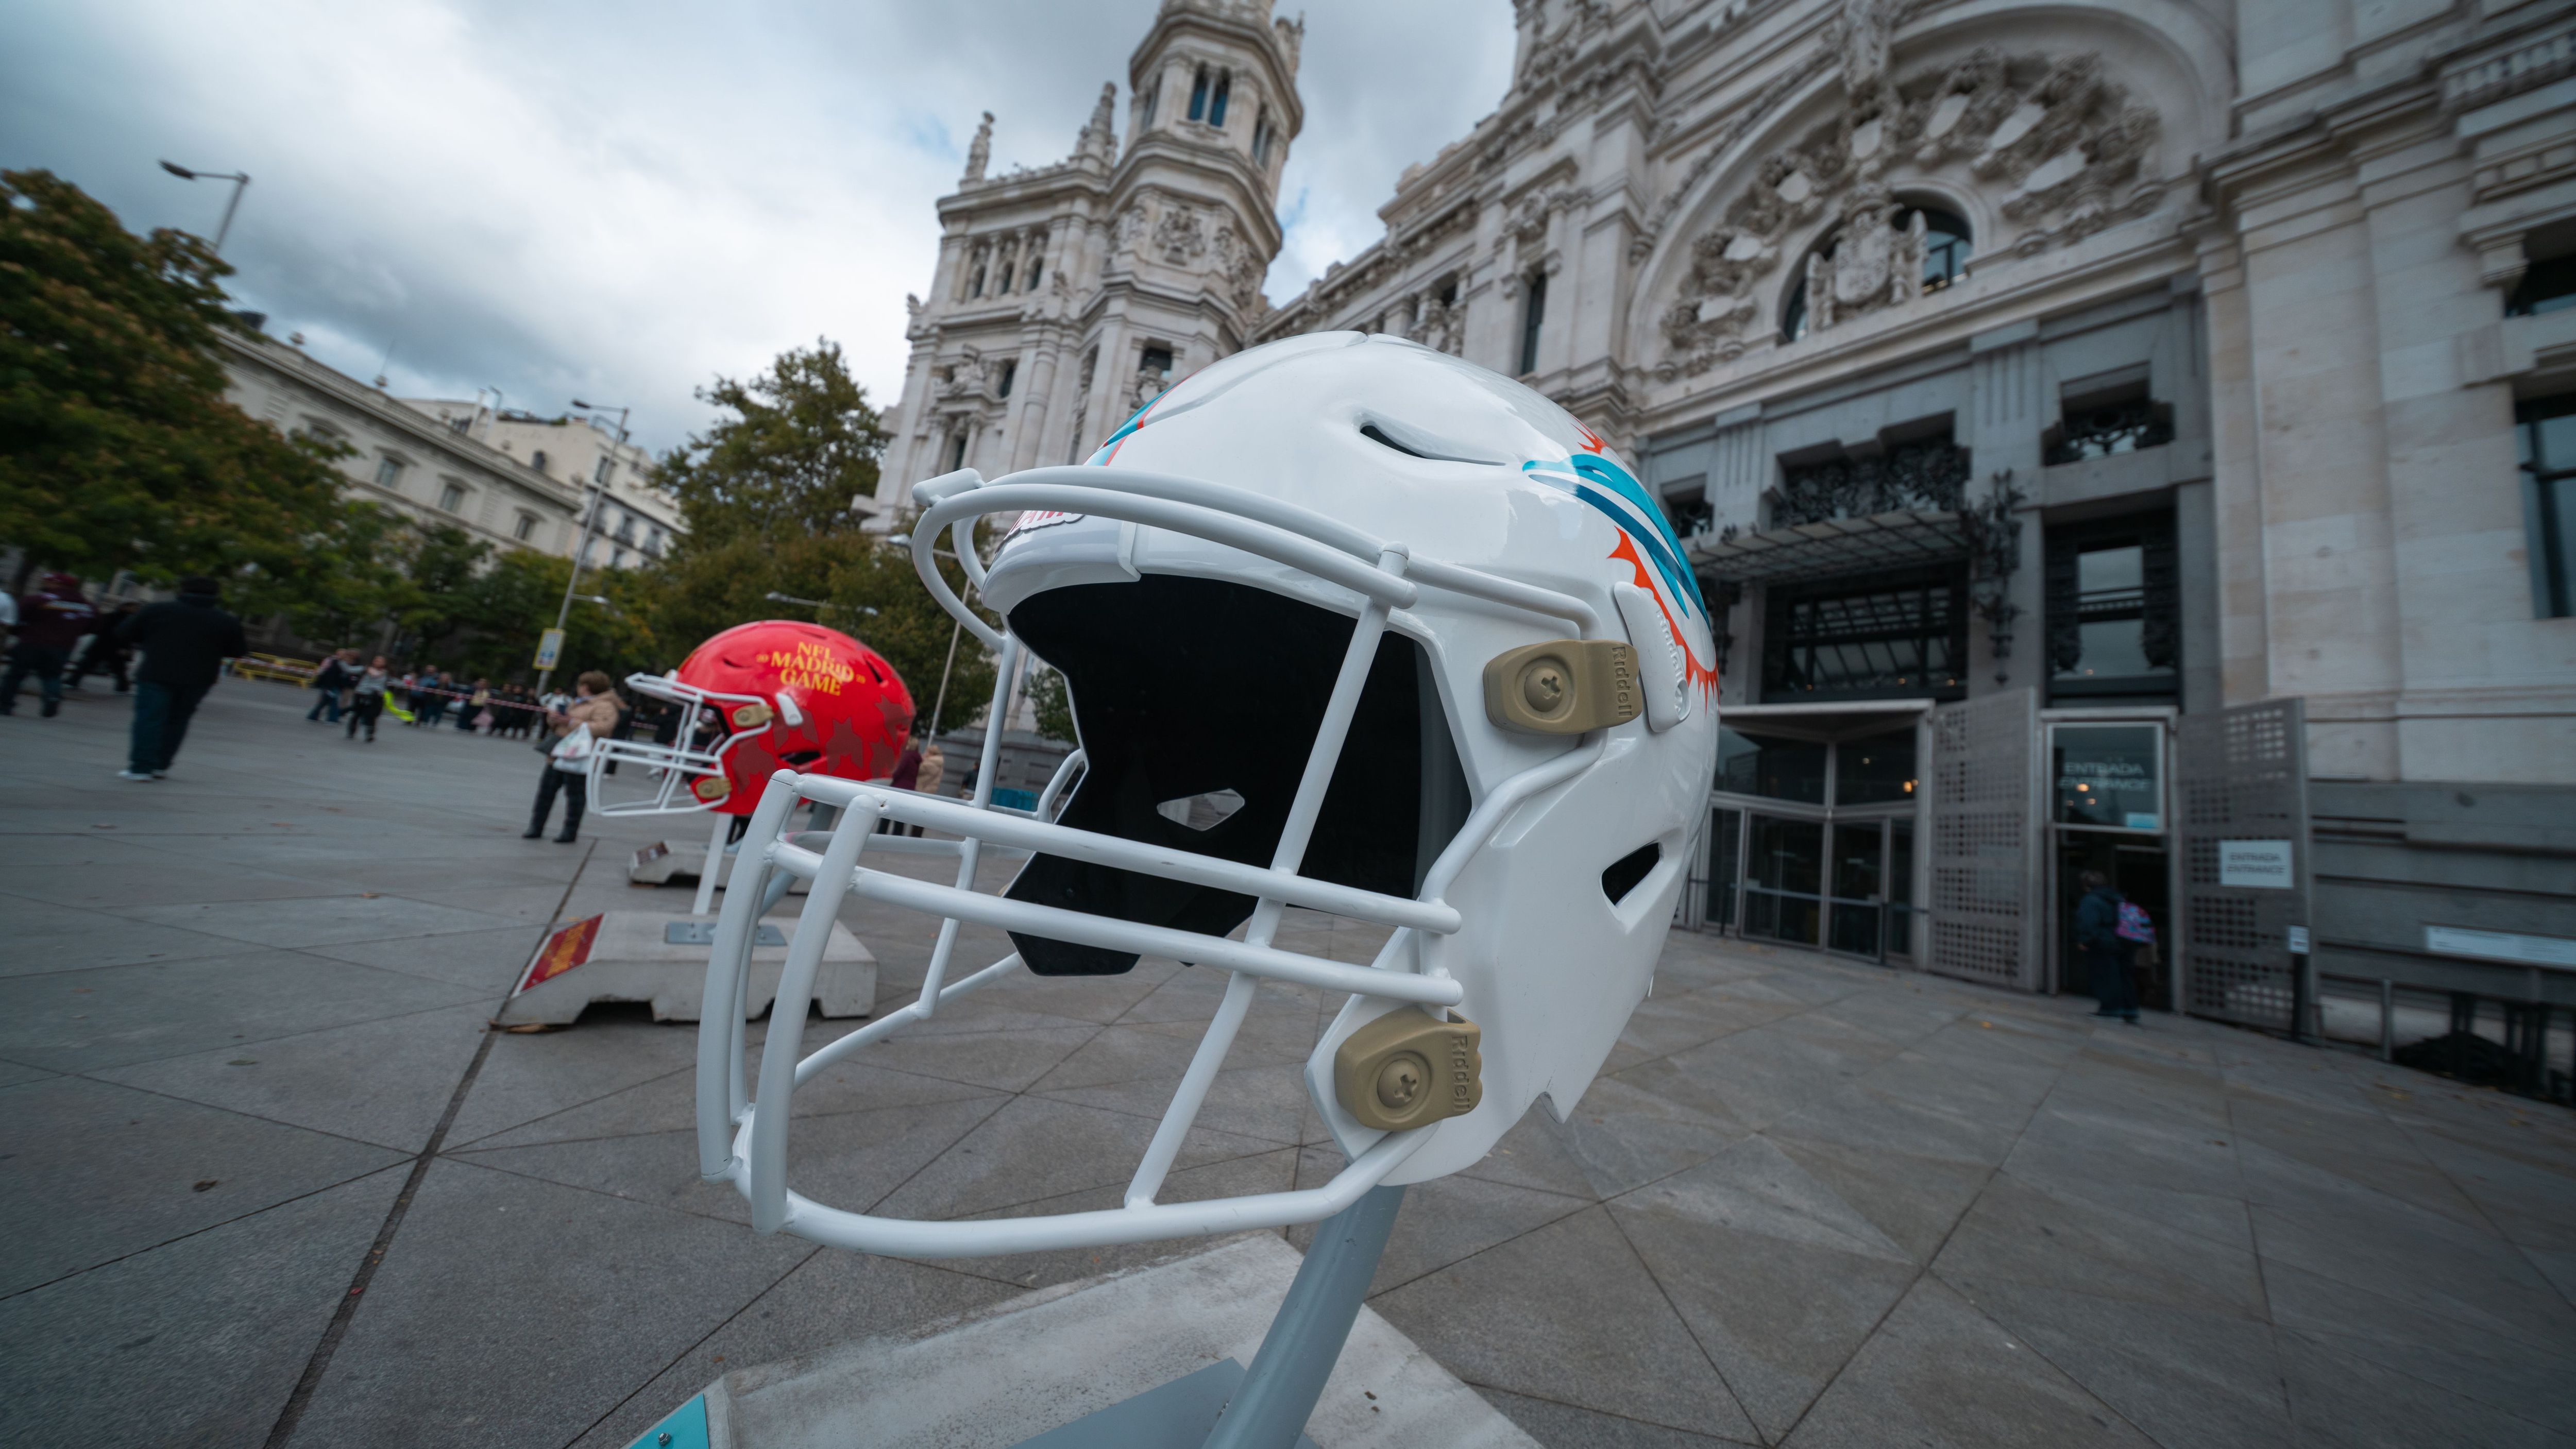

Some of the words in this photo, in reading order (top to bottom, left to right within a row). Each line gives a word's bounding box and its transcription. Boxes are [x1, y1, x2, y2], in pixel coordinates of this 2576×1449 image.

[798, 642, 831, 659] NFL
[771, 652, 854, 683] MADRID
[780, 668, 841, 696] GAME
[1612, 646, 1632, 717] Riddell
[2064, 762, 2144, 776] ENTRADA
[2229, 852, 2281, 862] ENTRADA
[2226, 863, 2287, 874] ENTRANCE
[1451, 1036, 1470, 1111] Riddell
